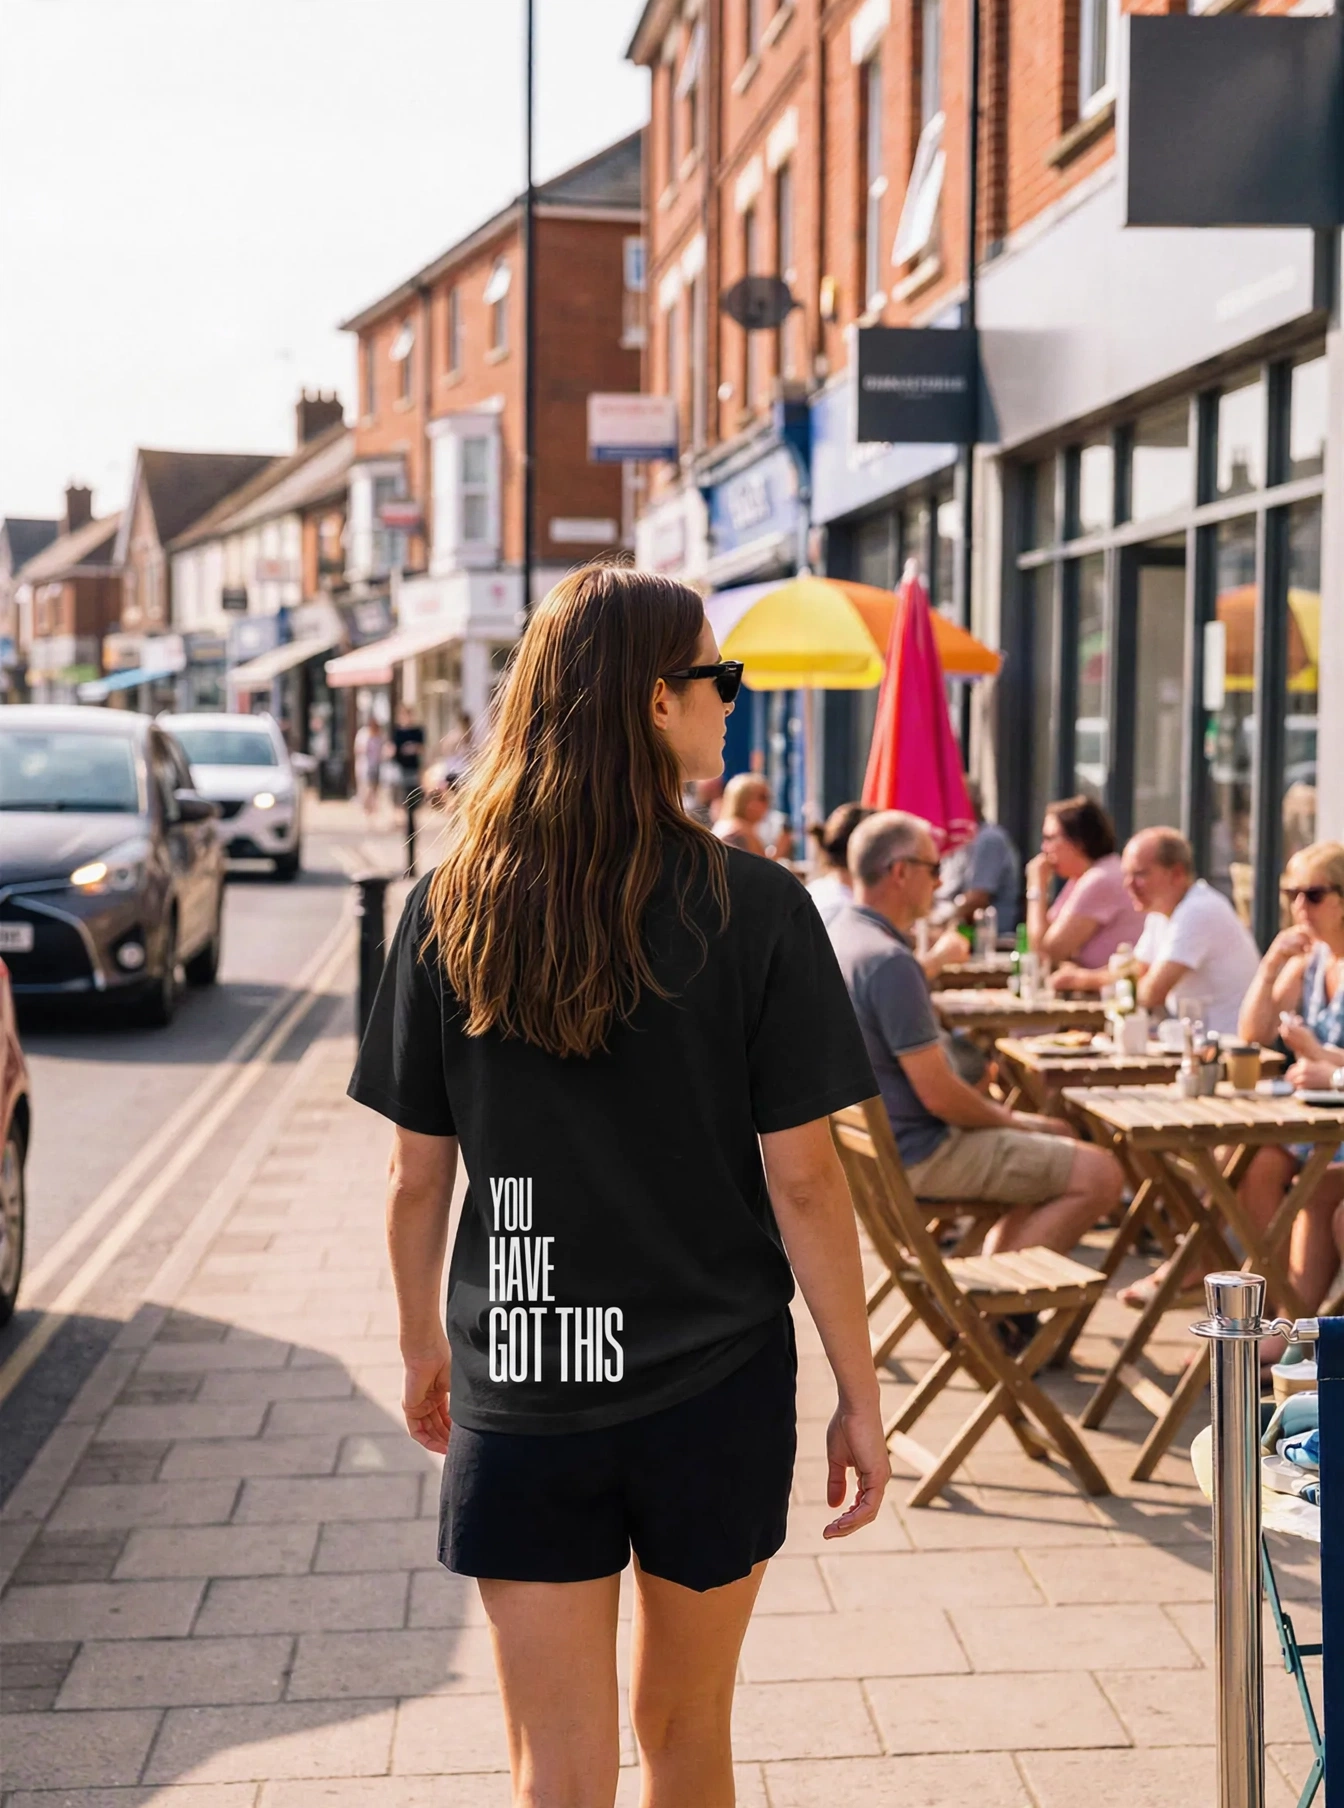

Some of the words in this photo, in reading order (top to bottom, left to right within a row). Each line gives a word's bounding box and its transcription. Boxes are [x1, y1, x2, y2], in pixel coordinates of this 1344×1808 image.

[489, 1177, 533, 1231] YOU
[489, 1236, 555, 1302] HAVE
[489, 1306, 547, 1382] GOT
[555, 1306, 624, 1382] THIS
